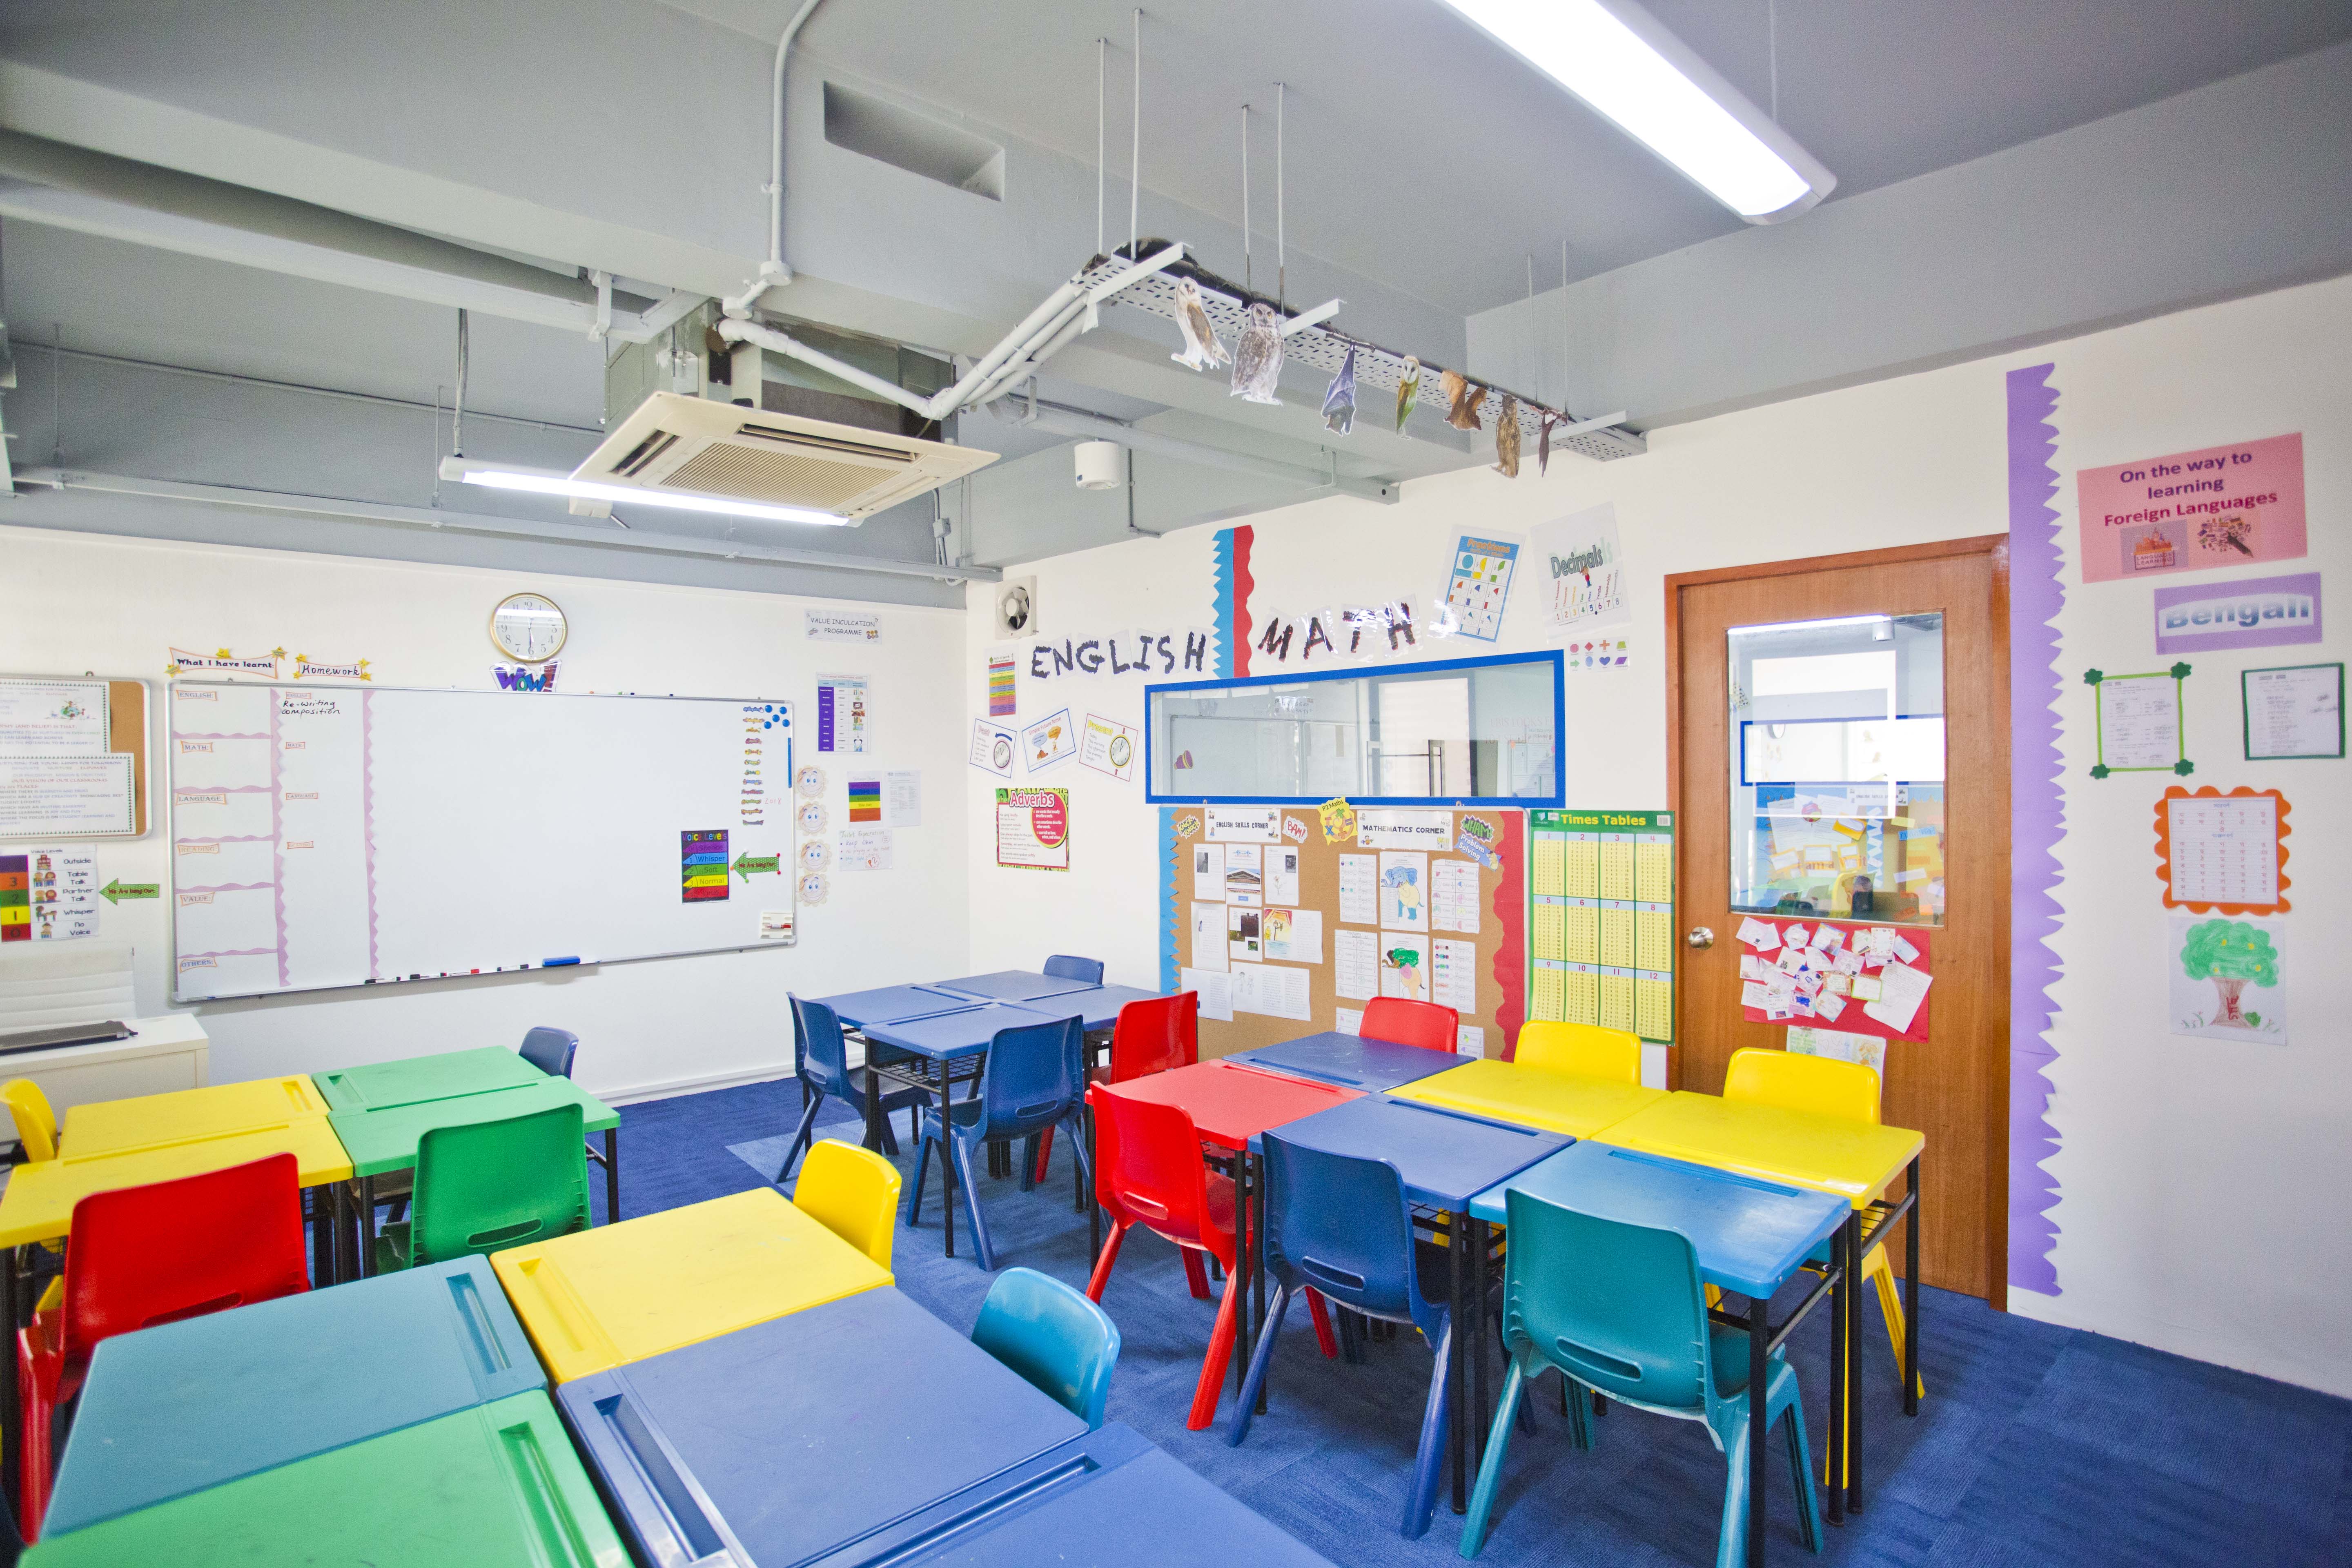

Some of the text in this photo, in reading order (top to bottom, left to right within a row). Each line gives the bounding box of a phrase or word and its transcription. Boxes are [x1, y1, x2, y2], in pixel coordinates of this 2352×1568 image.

[2120, 452, 2252, 483] On the way to
[2148, 477, 2224, 500] learning
[2104, 491, 2278, 527] Foreign Languages
[1467, 539, 1510, 554] Fractions
[1550, 544, 1603, 579] Decimals
[2136, 552, 2174, 561] LANGUAGE
[2136, 557, 2174, 566] LEARNING
[2165, 598, 2310, 630] Bengali
[832, 619, 875, 627] INCULCATION
[824, 628, 862, 636] PROGRAMME
[1257, 601, 1416, 663] MATH
[506, 635, 511, 644] 8
[548, 635, 554, 644] 4
[528, 646, 534, 655] 6
[541, 644, 546, 652] 5
[1030, 630, 1207, 680] ENGLISH
[177, 658, 203, 667] What
[301, 664, 361, 676] Homework
[283, 700, 335, 710] Re-writing
[281, 708, 340, 719] composition
[1028, 717, 1062, 735] Simple Future Tense
[1010, 790, 1055, 807] Adverbs
[1330, 799, 1344, 808] Maths
[1560, 814, 1647, 826] Times Tables
[1287, 820, 1306, 839] BAM!
[1363, 825, 1413, 833] MATHEMATICS
[682, 832, 727, 841] Voice Levels
[1460, 833, 1485, 853] Problem
[1458, 842, 1481, 862] Solving
[181, 959, 214, 968] OTHERS:
